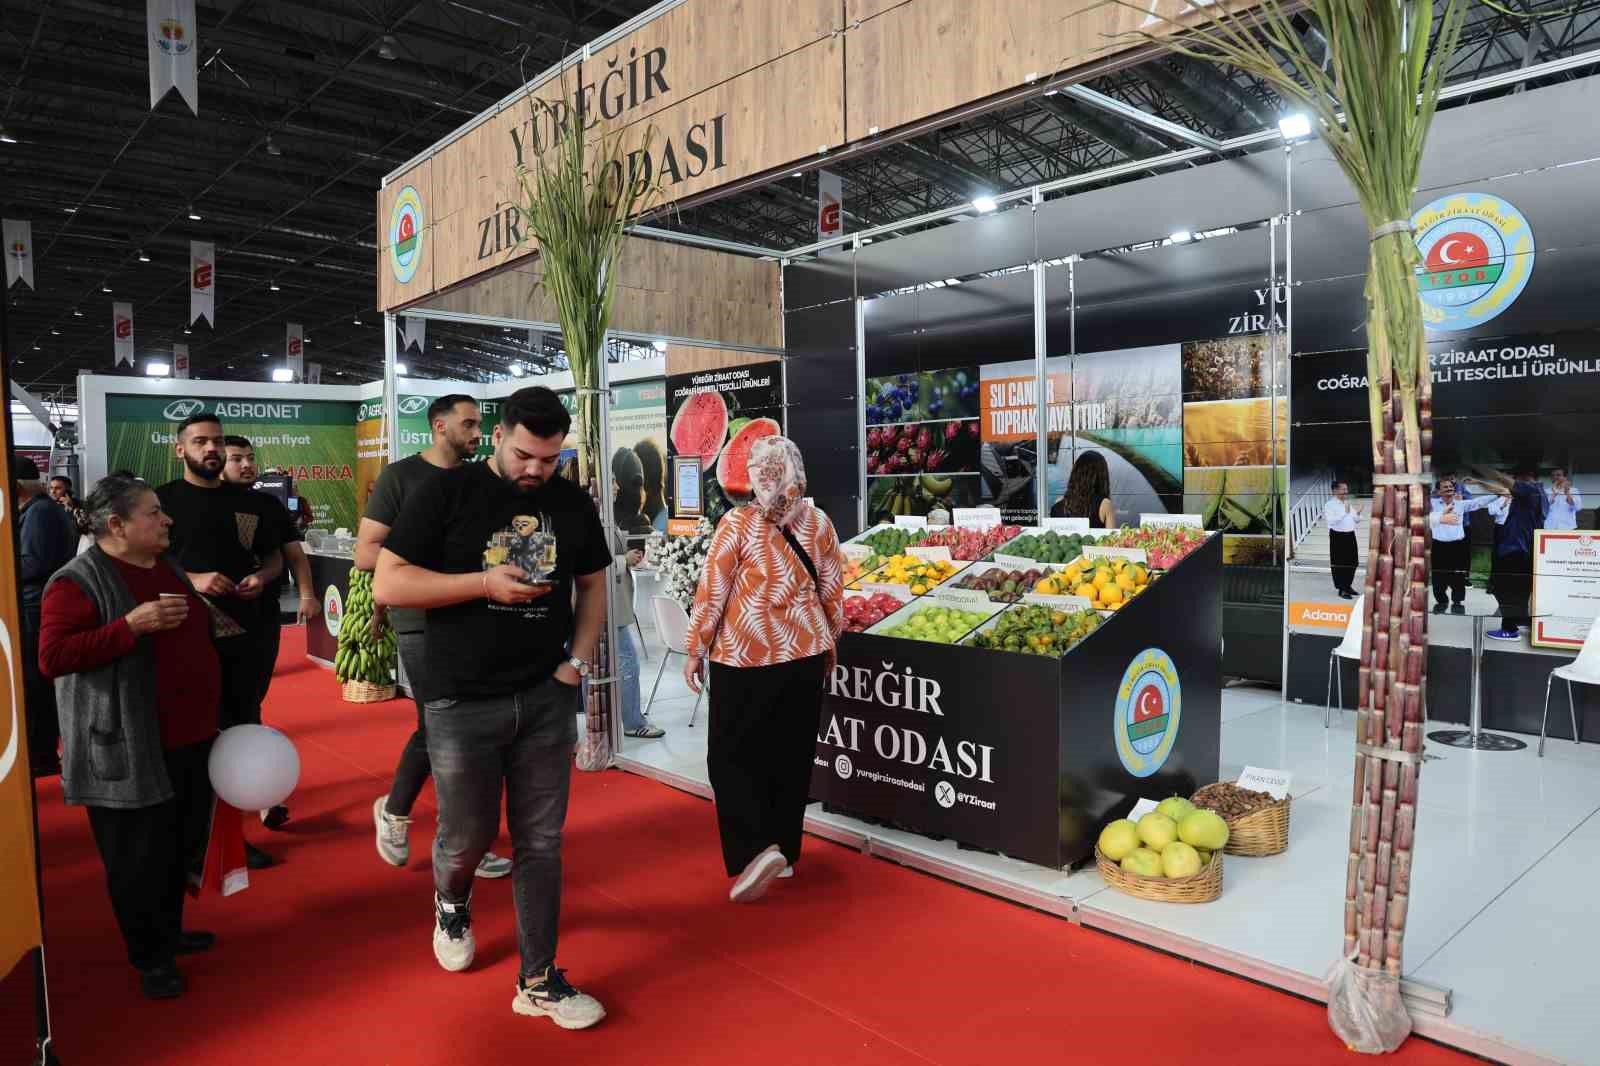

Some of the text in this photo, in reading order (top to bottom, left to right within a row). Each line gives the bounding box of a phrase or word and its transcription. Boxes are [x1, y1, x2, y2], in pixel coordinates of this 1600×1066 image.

[509, 45, 672, 168] YÜREĞİR
[600, 113, 727, 210] ODASI
[1440, 348, 1498, 366] ZİRAAT
[1500, 344, 1556, 361] ODASI
[714, 372, 732, 383] ZİRAAT
[732, 370, 750, 380] ODASI
[742, 375, 770, 389] ÜRÜNLERİ
[1317, 373, 1370, 391] COĞRA
[1453, 360, 1528, 381] TESCİLLİ
[991, 383, 1006, 408] SU
[215, 402, 302, 419] AGRONET
[990, 408, 1038, 435] TOPRAK
[282, 432, 312, 448] fiyat
[1302, 608, 1347, 623] Adana
[828, 660, 945, 716] REĞİR
[873, 724, 996, 784] ODASI
[957, 791, 997, 811] @YZiraat
